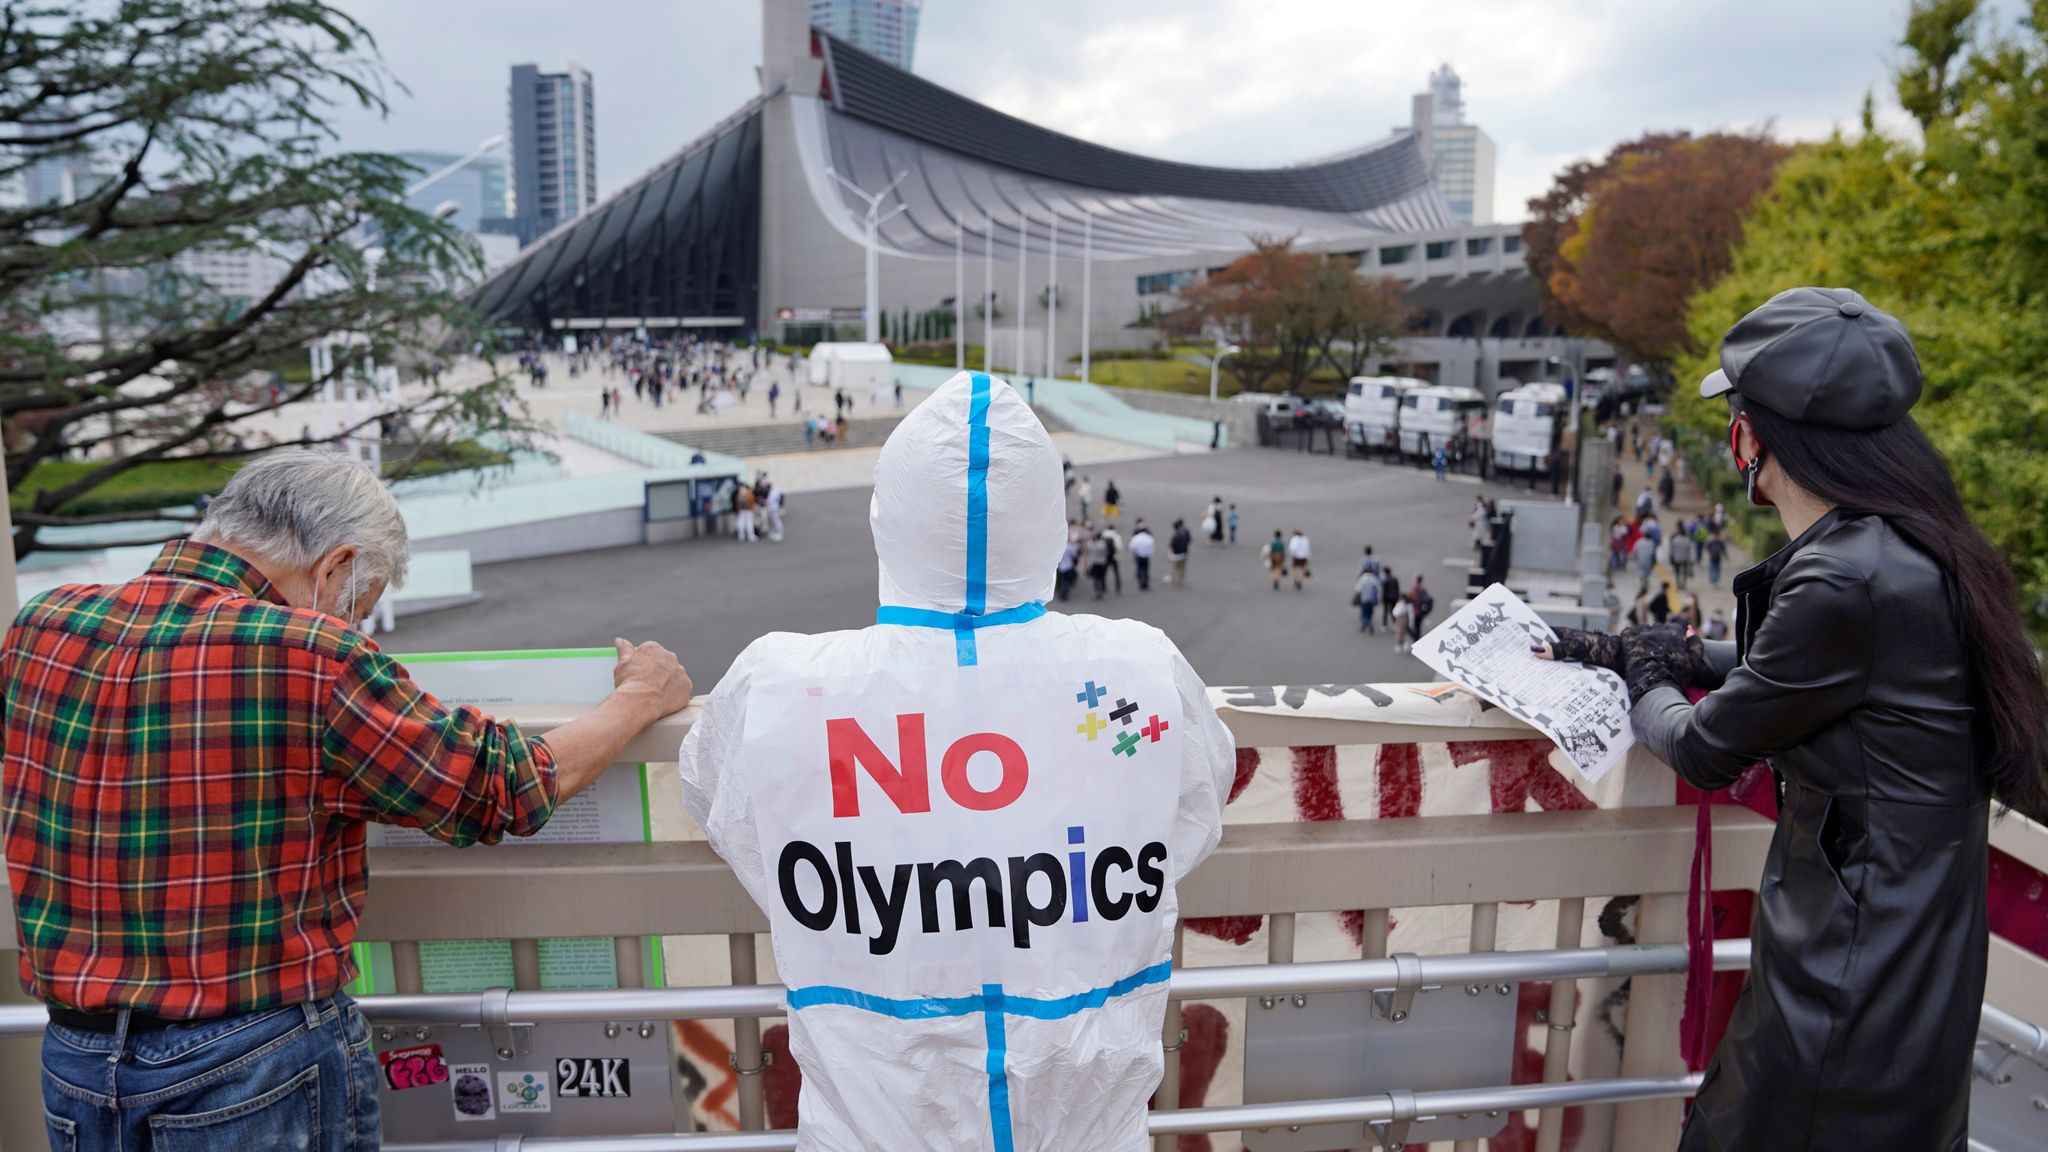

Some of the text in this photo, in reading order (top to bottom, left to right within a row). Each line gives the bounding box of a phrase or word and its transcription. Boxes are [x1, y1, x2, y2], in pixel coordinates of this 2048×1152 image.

[826, 713, 1029, 817] No
[778, 826, 1167, 955] Olympics
[455, 1066, 487, 1075] HELLO
[558, 1058, 628, 1097] 24K
